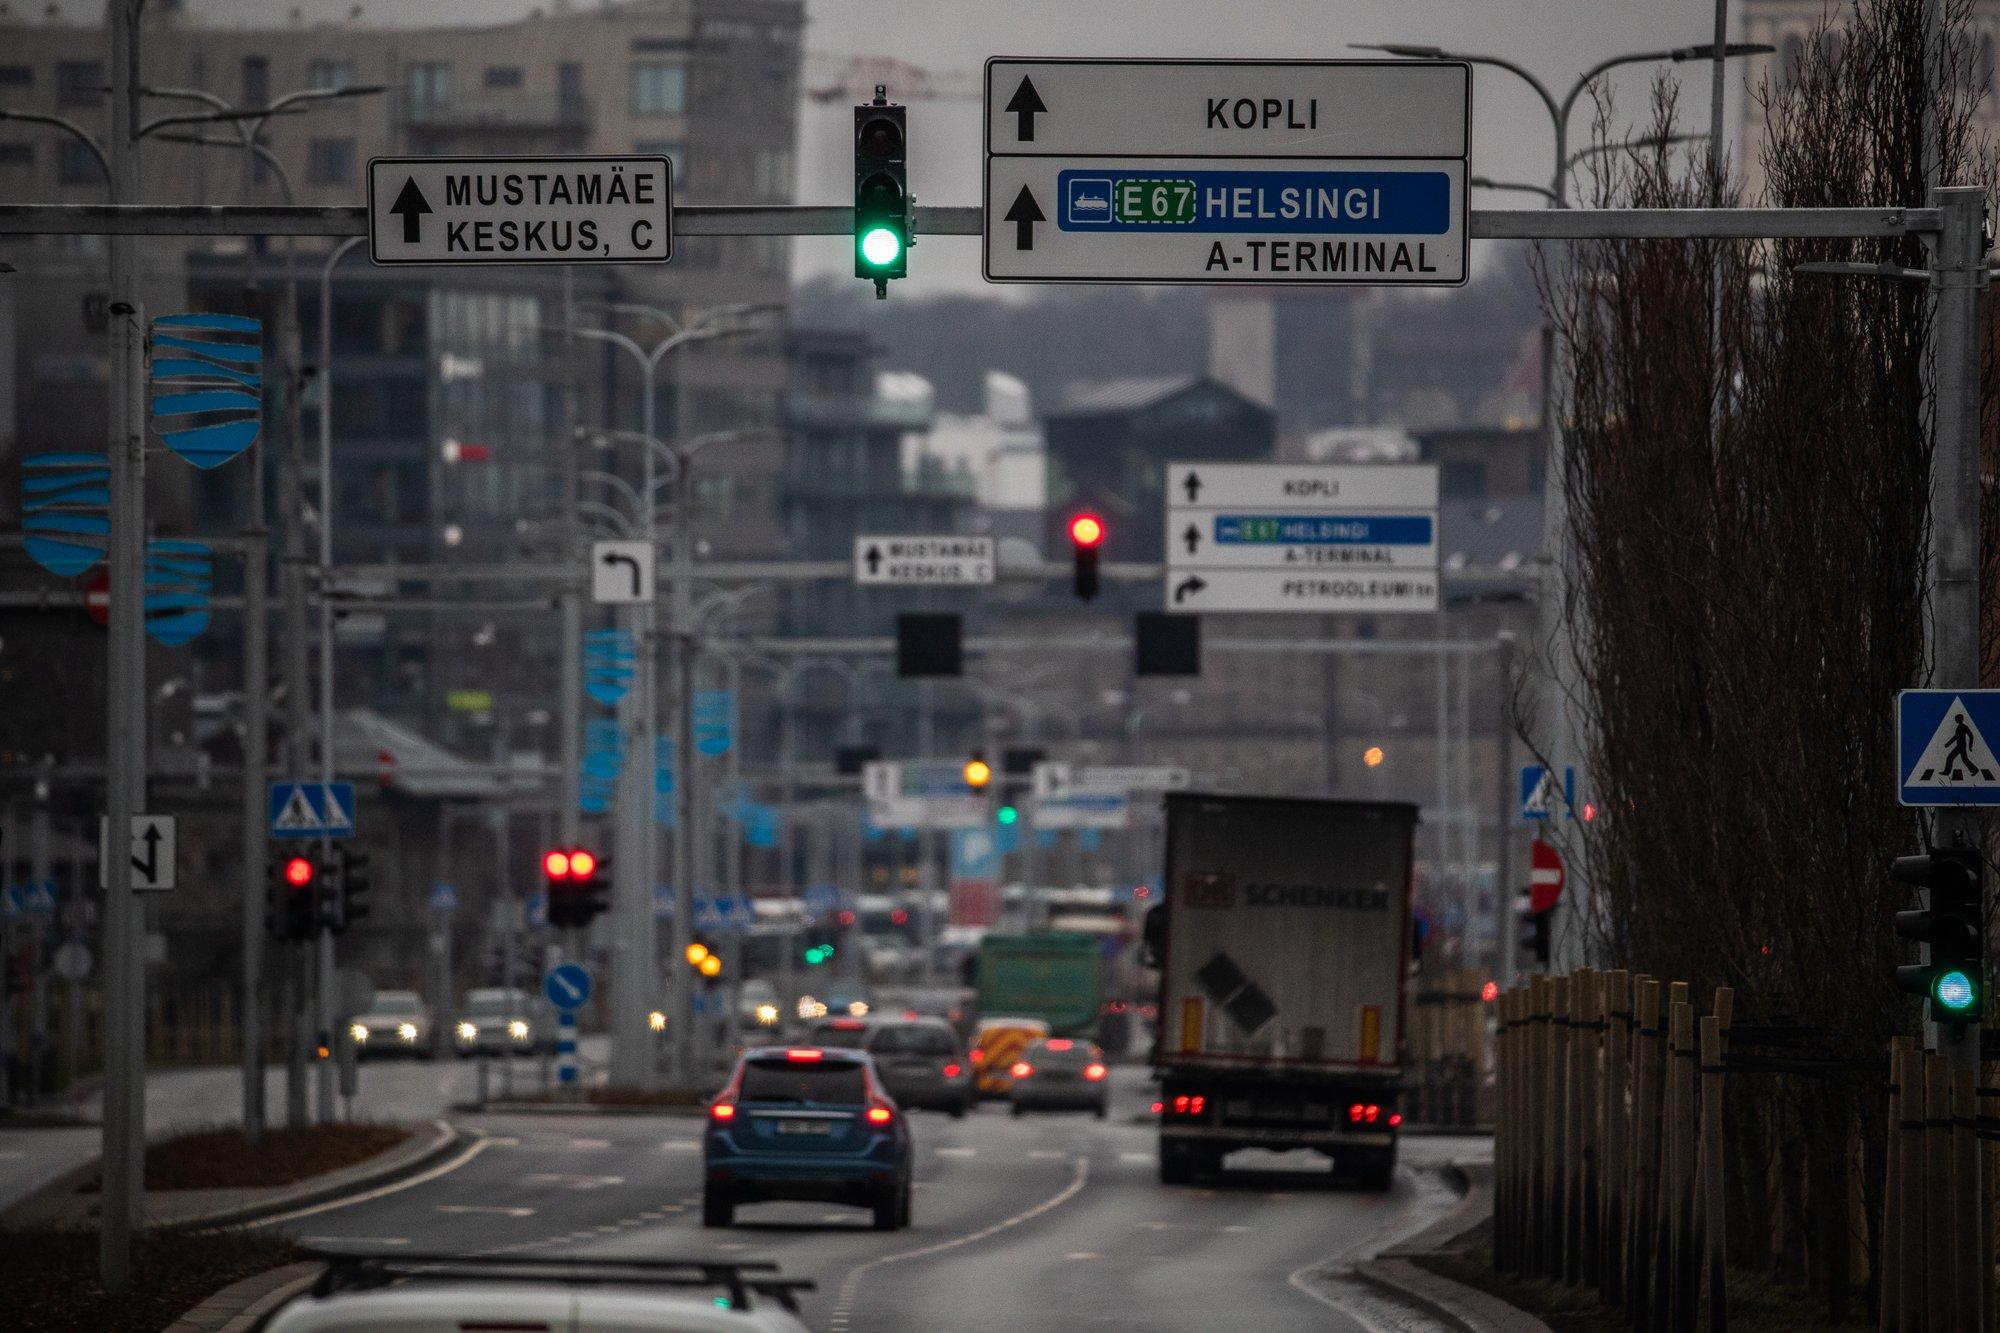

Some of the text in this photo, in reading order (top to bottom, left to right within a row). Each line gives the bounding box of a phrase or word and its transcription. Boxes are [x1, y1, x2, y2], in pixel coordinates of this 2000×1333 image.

[1206, 98, 1317, 130] KOPLI
[446, 165, 654, 206] MUSTAMÄE
[1122, 186, 1380, 219] E 67 HELSINGI
[447, 219, 653, 256] KESKUS, C
[1205, 240, 1437, 273] A-TERMINAL
[1283, 480, 1340, 497] KOPLI
[1283, 522, 1370, 539] HELSINGI
[1246, 883, 1390, 913] SCHENKER
